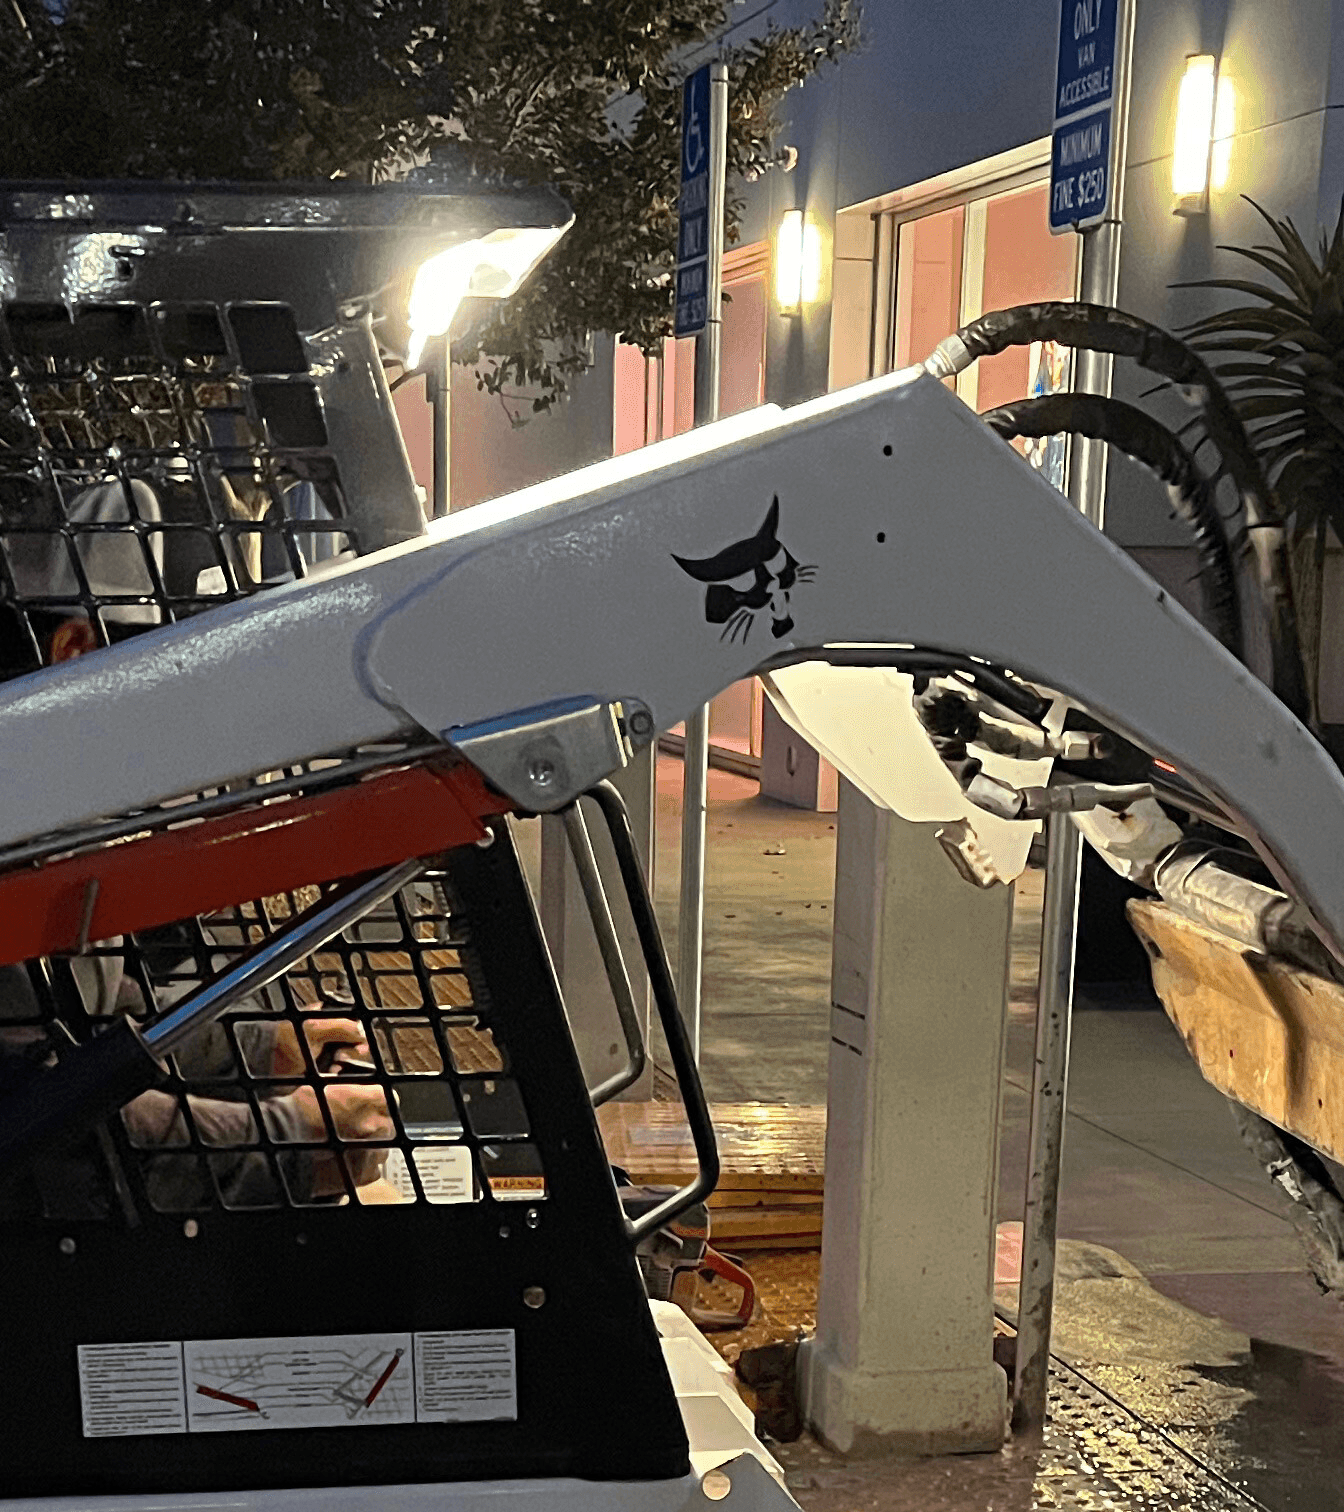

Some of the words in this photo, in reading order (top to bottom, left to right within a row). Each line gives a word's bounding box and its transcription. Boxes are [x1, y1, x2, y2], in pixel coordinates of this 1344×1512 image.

[1074, 0, 1101, 40] ONLY
[1078, 42, 1096, 69] VAN
[1059, 66, 1110, 109] ACCESSIBLE
[1060, 122, 1103, 166] MINIMUM
[1053, 177, 1075, 212] FINE
[1077, 167, 1104, 209] $250
